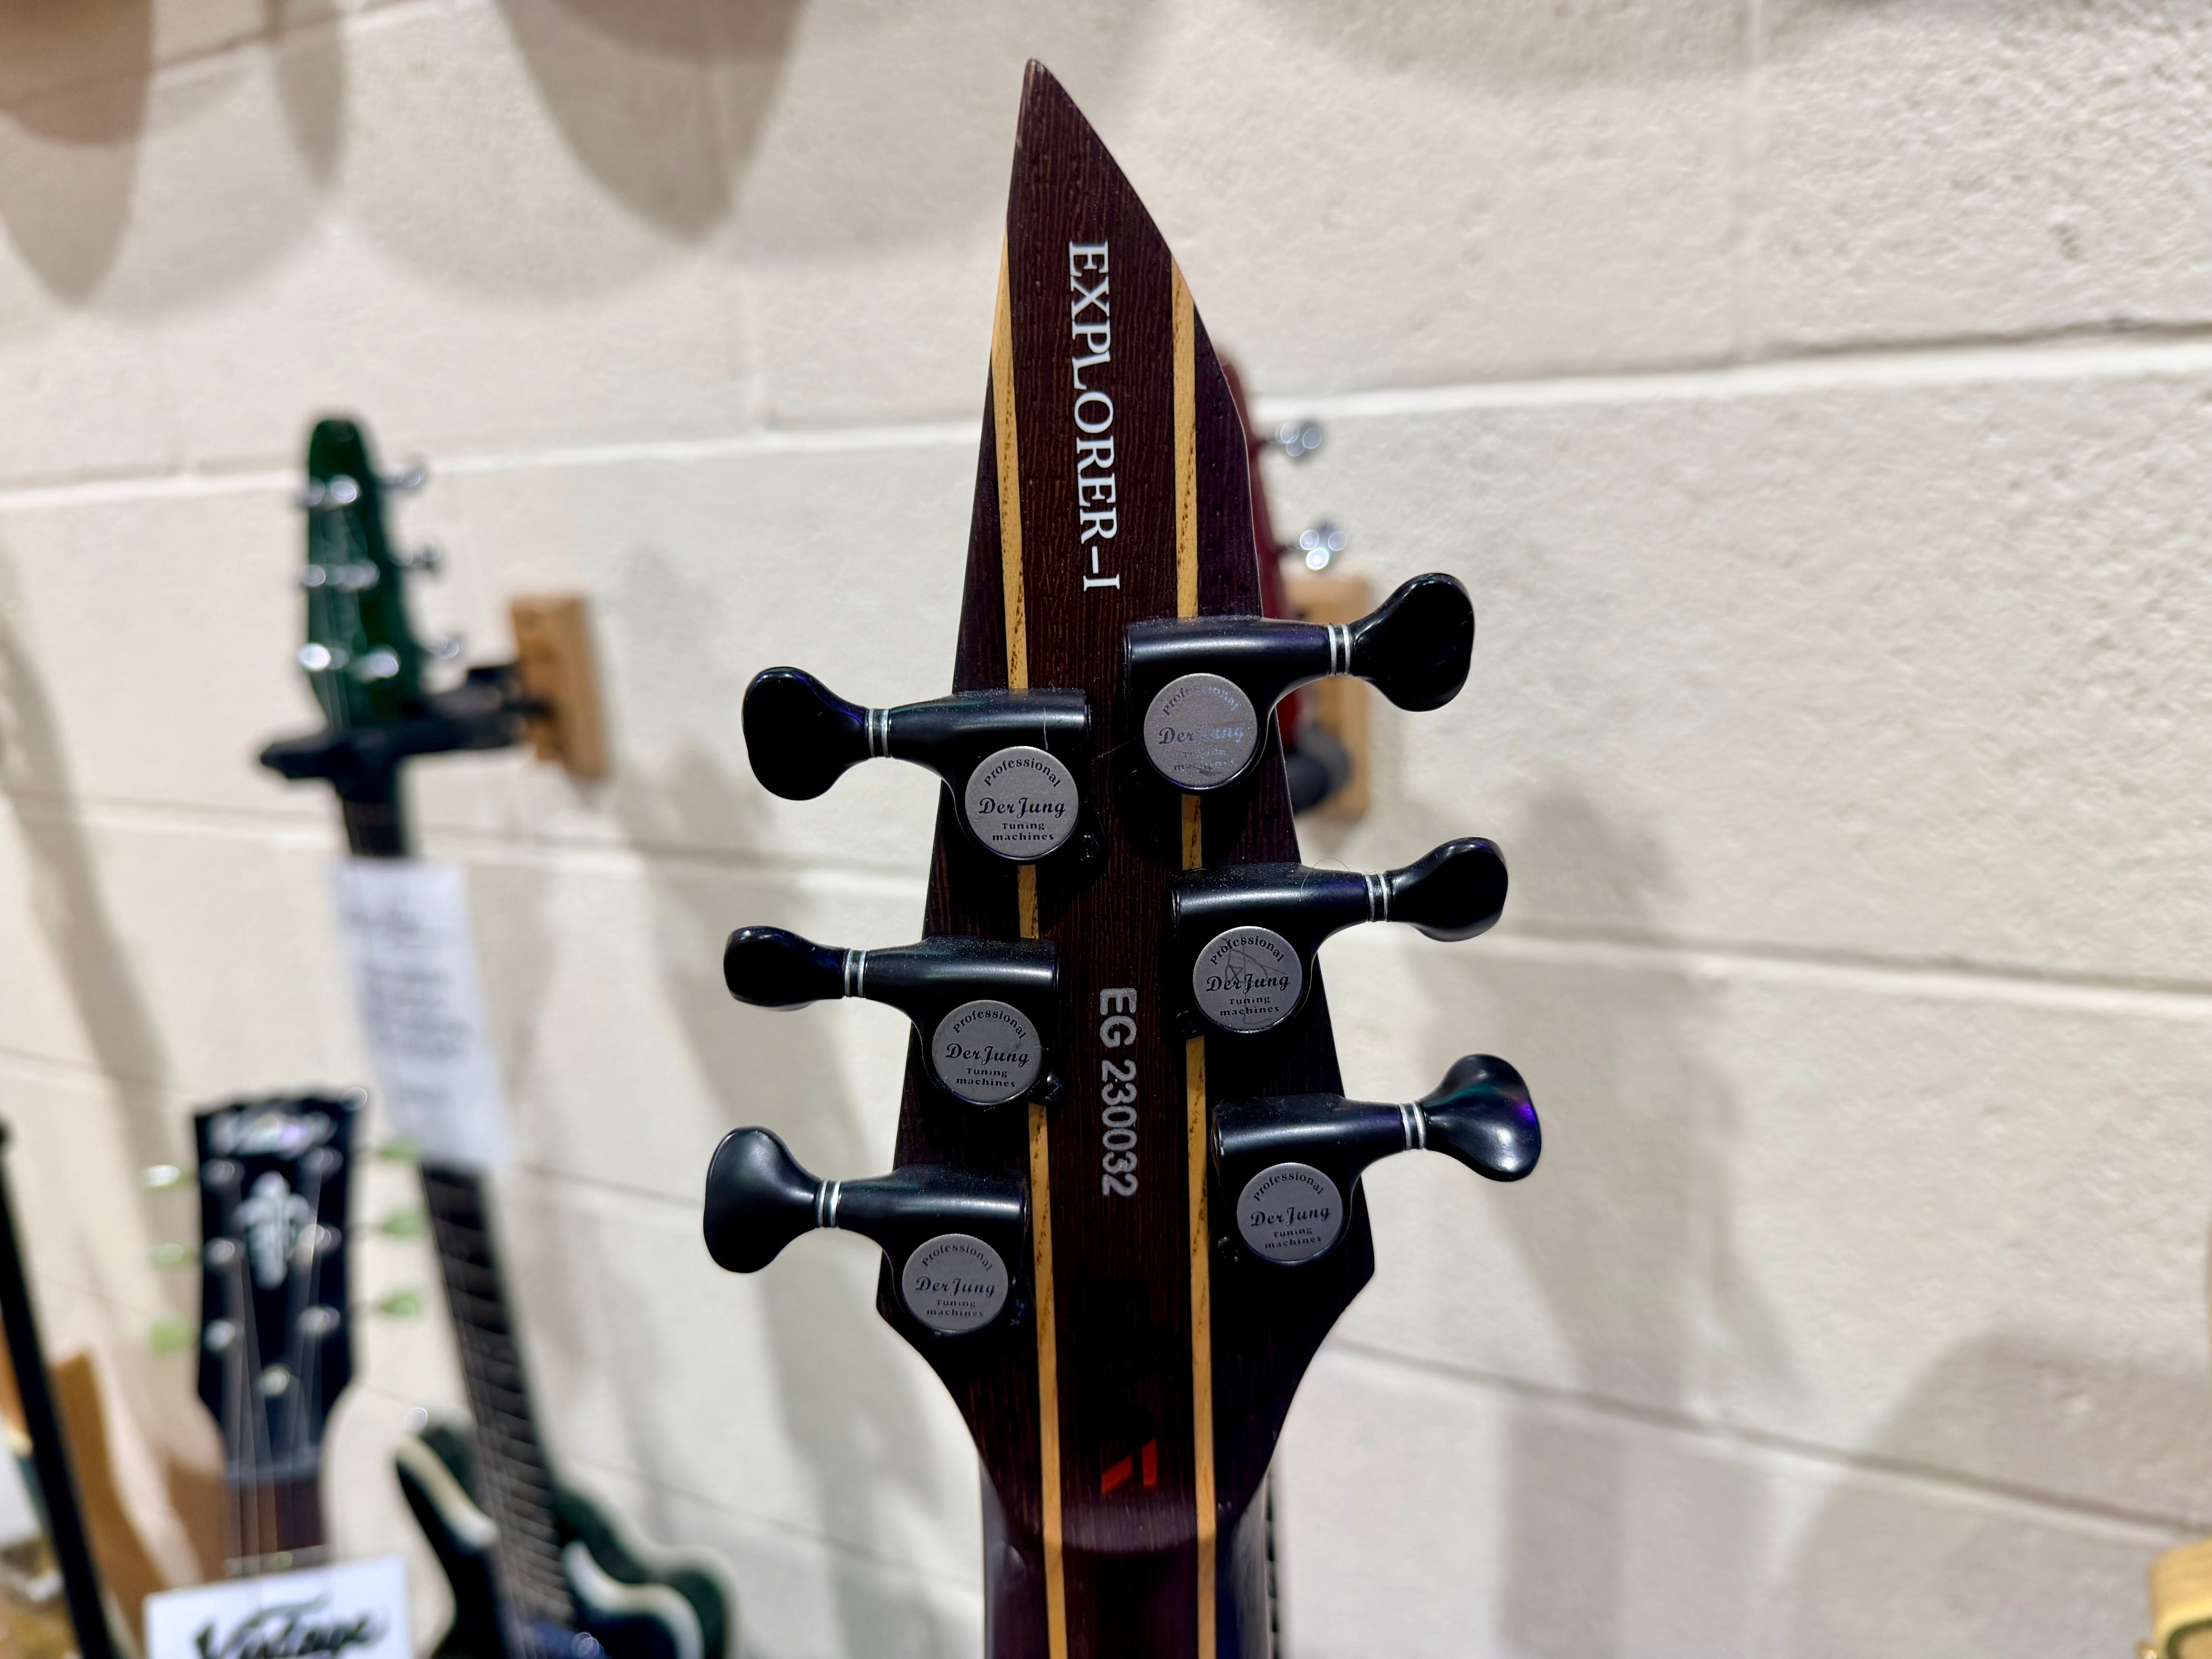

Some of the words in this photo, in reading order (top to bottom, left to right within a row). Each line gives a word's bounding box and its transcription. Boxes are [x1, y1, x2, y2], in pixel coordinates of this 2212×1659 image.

[1068, 240, 1120, 592] EXPLORER-I
[984, 758, 1061, 788] Professional
[993, 833, 1054, 841] machines
[1210, 935, 1285, 965] Professional
[1228, 996, 1270, 1005] Tuning
[1100, 988, 1137, 1048] EG
[1220, 1006, 1280, 1017] machines
[953, 1010, 1027, 1039] Professional
[967, 1068, 1008, 1078] Tuning
[956, 1078, 1015, 1087] machines
[1101, 1059, 1139, 1197] 230032
[1253, 1172, 1324, 1202] Professional
[1273, 1228, 1313, 1238] Tuning
[1264, 1236, 1322, 1249] machines
[921, 1244, 993, 1271] Professional
[936, 1299, 975, 1308] Tuning
[926, 1309, 984, 1317] machines
